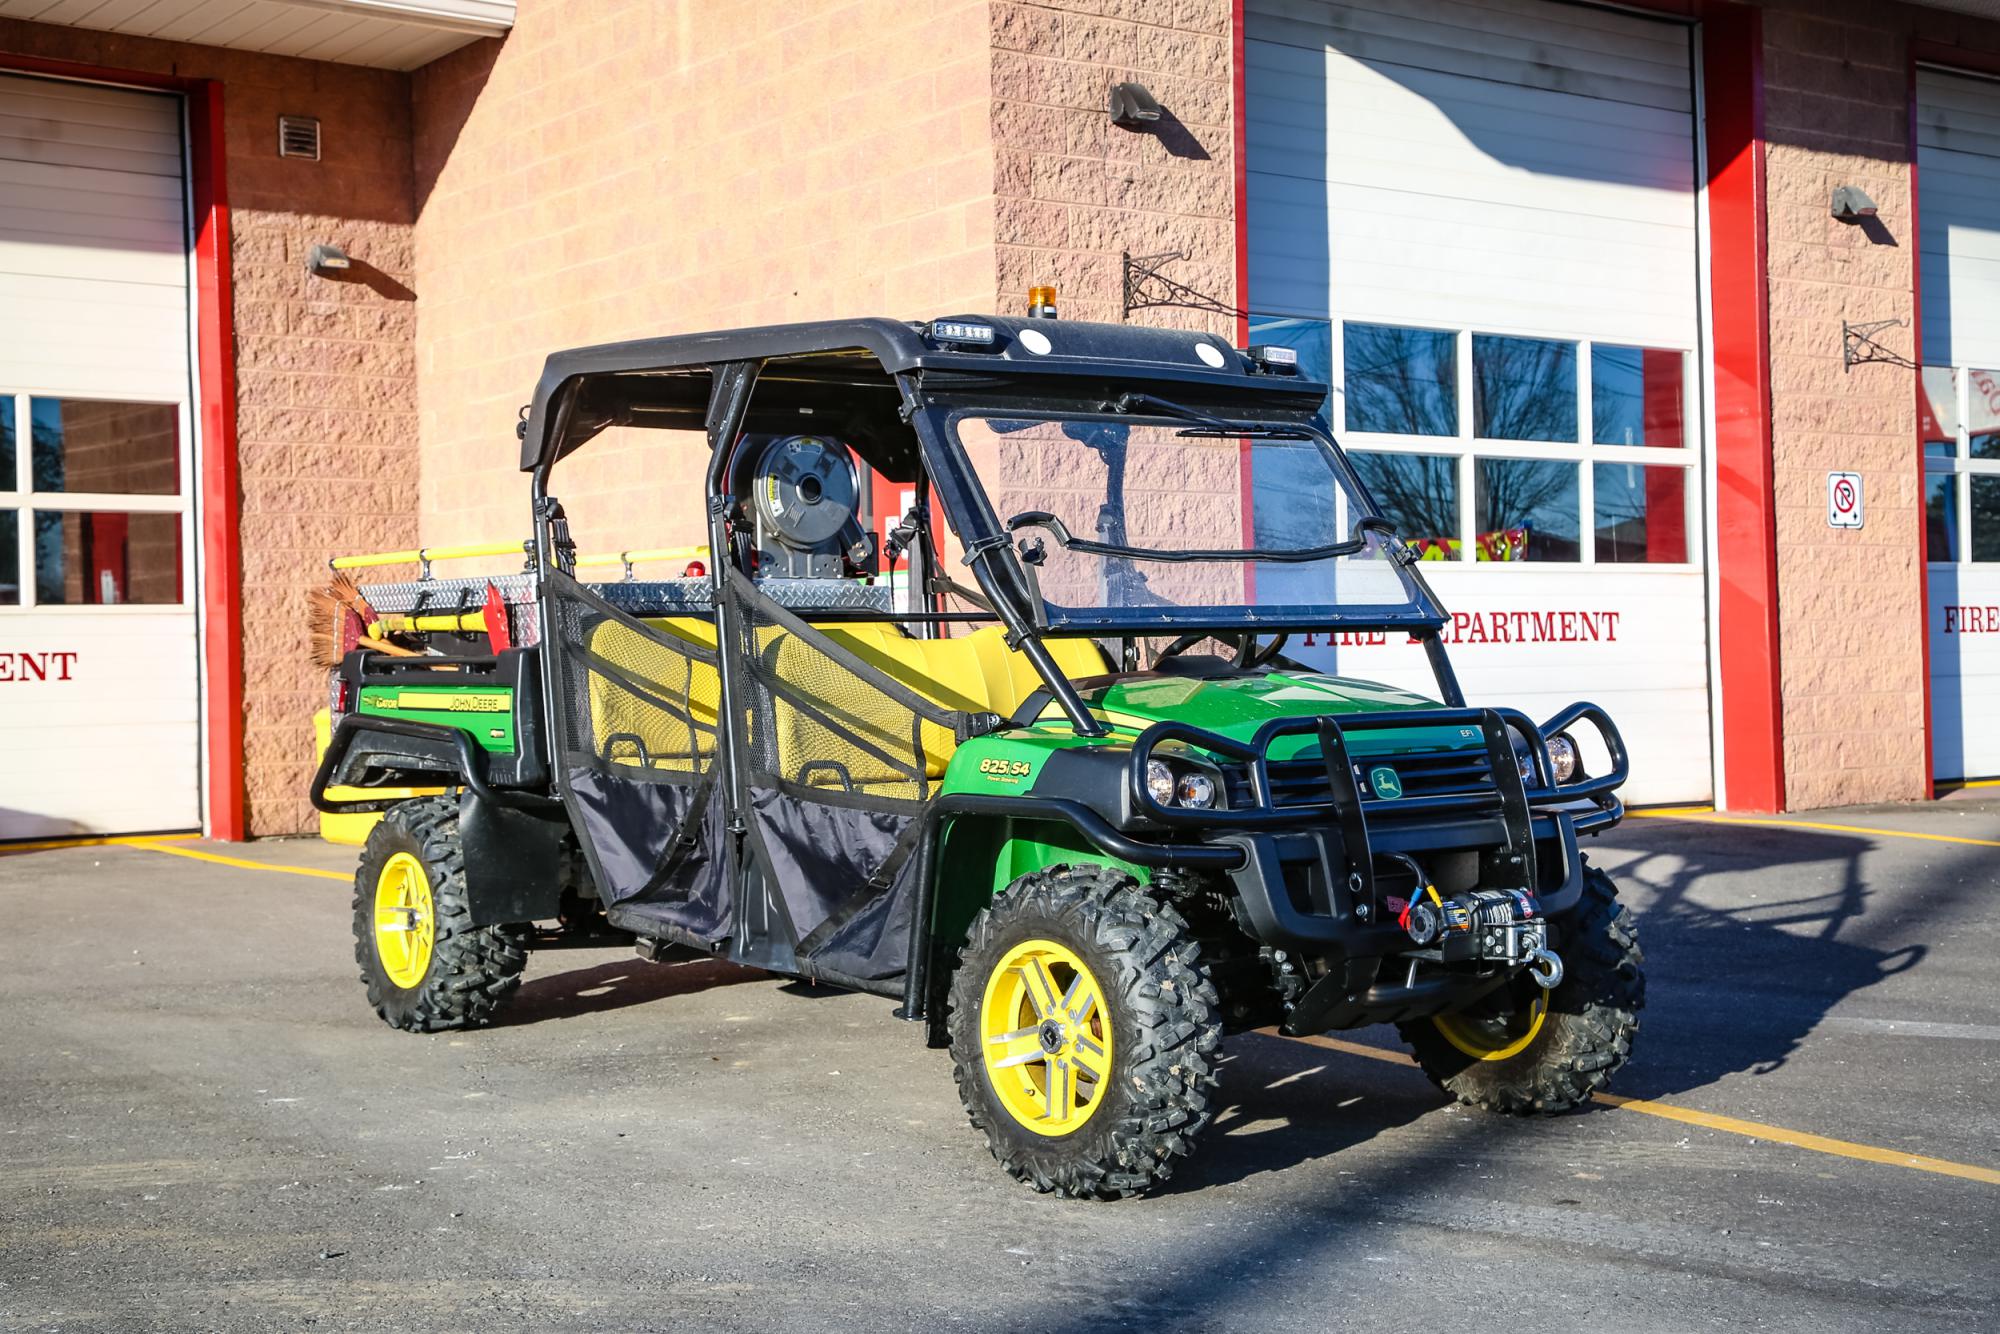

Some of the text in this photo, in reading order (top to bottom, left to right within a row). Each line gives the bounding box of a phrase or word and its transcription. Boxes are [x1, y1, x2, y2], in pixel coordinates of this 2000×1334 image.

[1943, 606, 1999, 633] FIRE
[450, 696, 498, 710] JOHN DEERE
